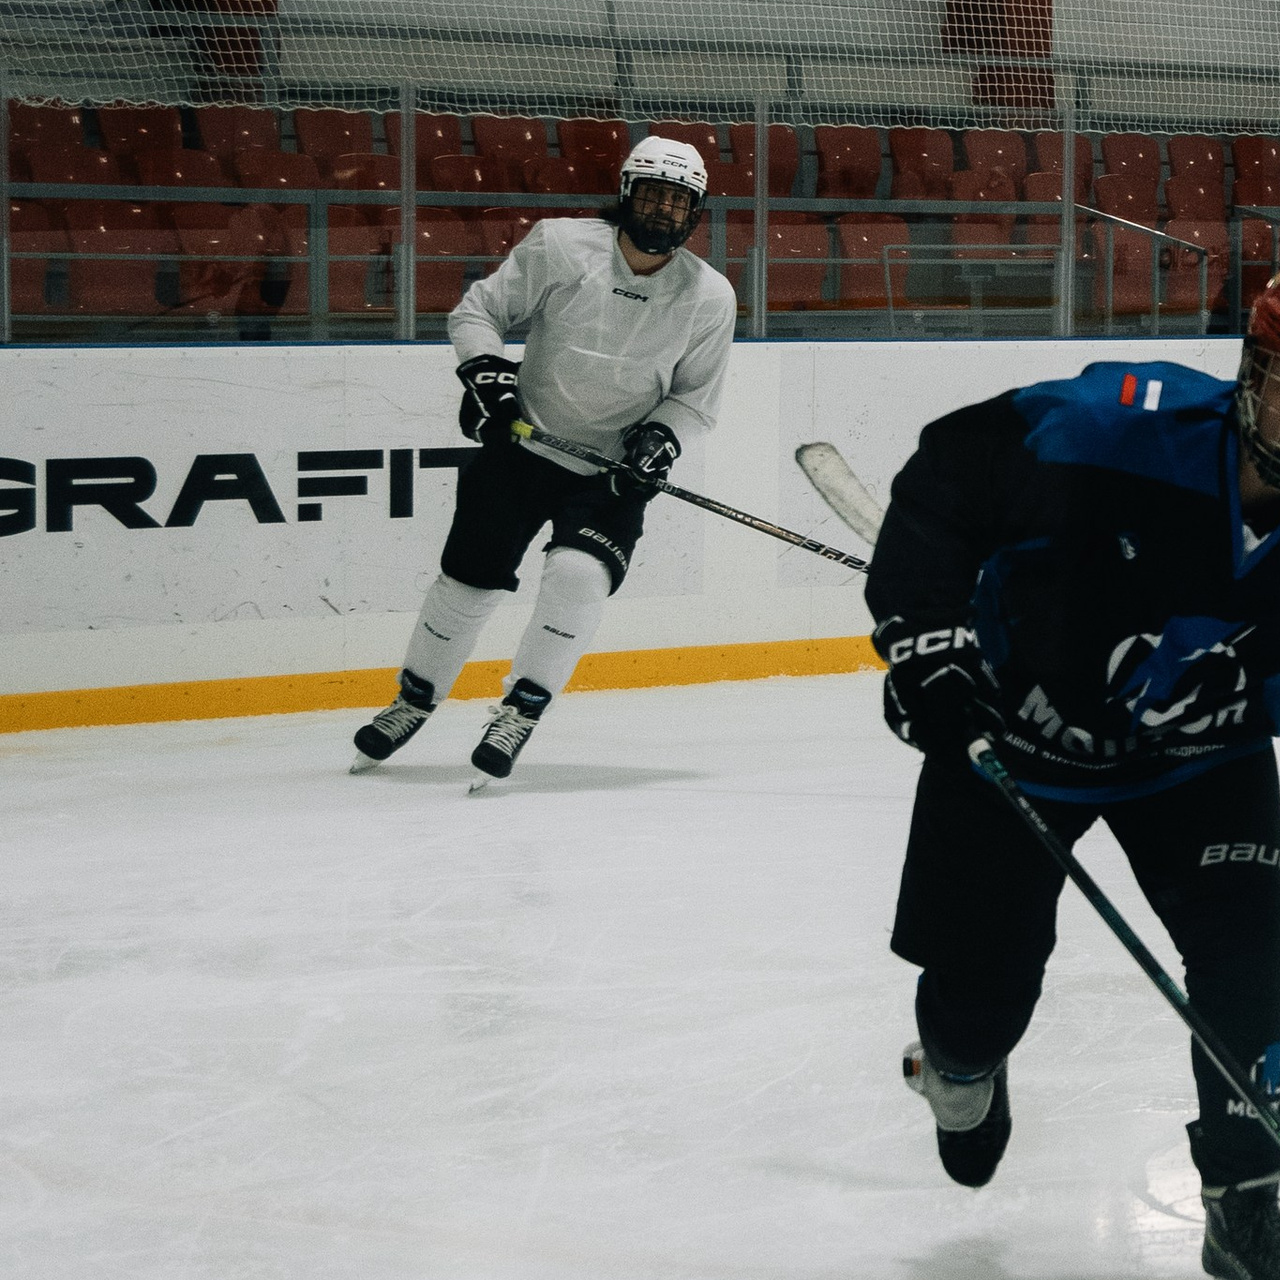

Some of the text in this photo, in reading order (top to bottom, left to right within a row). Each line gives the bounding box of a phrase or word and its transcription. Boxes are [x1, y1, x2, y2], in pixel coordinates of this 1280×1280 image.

[662, 159, 688, 170] CCM
[612, 287, 649, 302] CCM
[474, 371, 518, 385] CC
[890, 626, 980, 664] CCM
